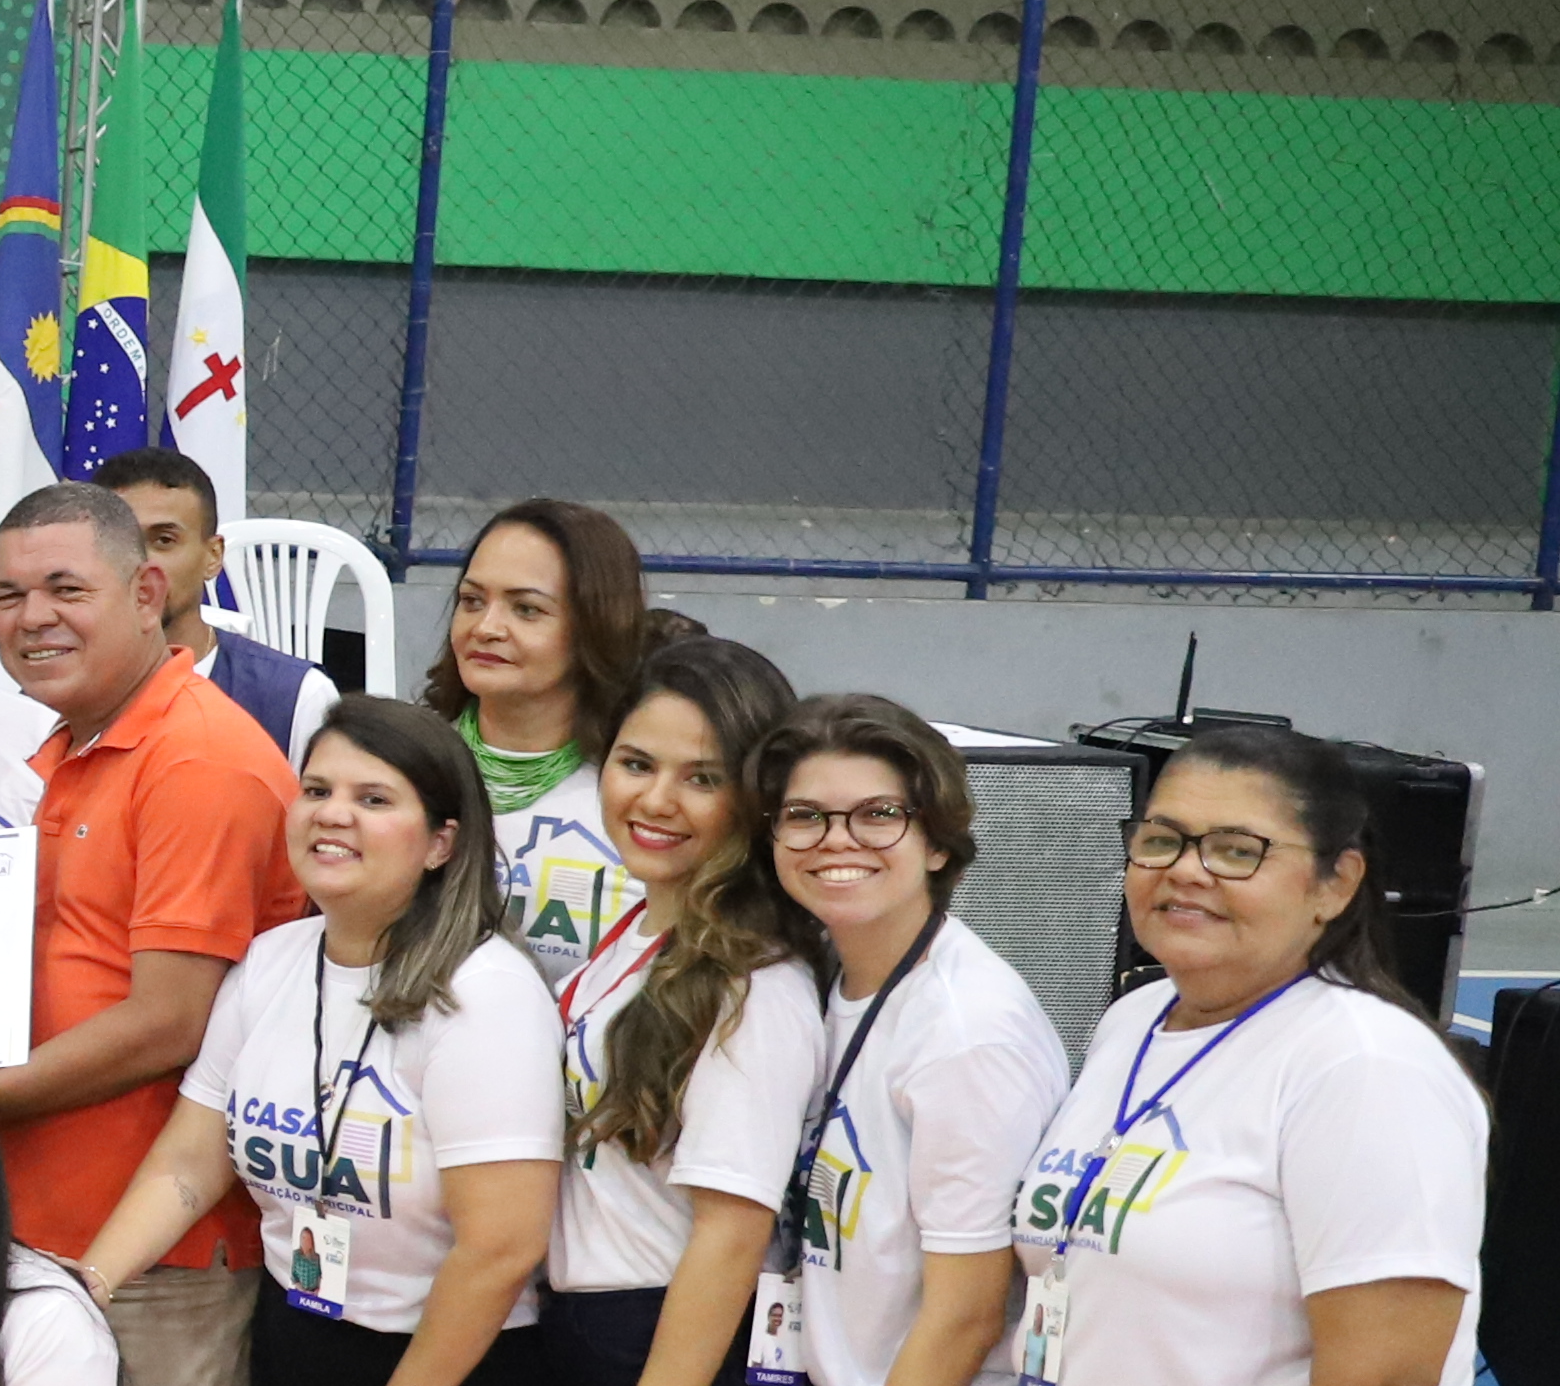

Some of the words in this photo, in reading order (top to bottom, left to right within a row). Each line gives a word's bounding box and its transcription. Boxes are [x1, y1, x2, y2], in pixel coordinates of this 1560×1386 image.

[102, 307, 143, 362] ORDEM
[243, 1135, 373, 1205] SUA
[299, 1296, 331, 1314] KAMILA
[755, 1371, 795, 1385] TAMIRES
